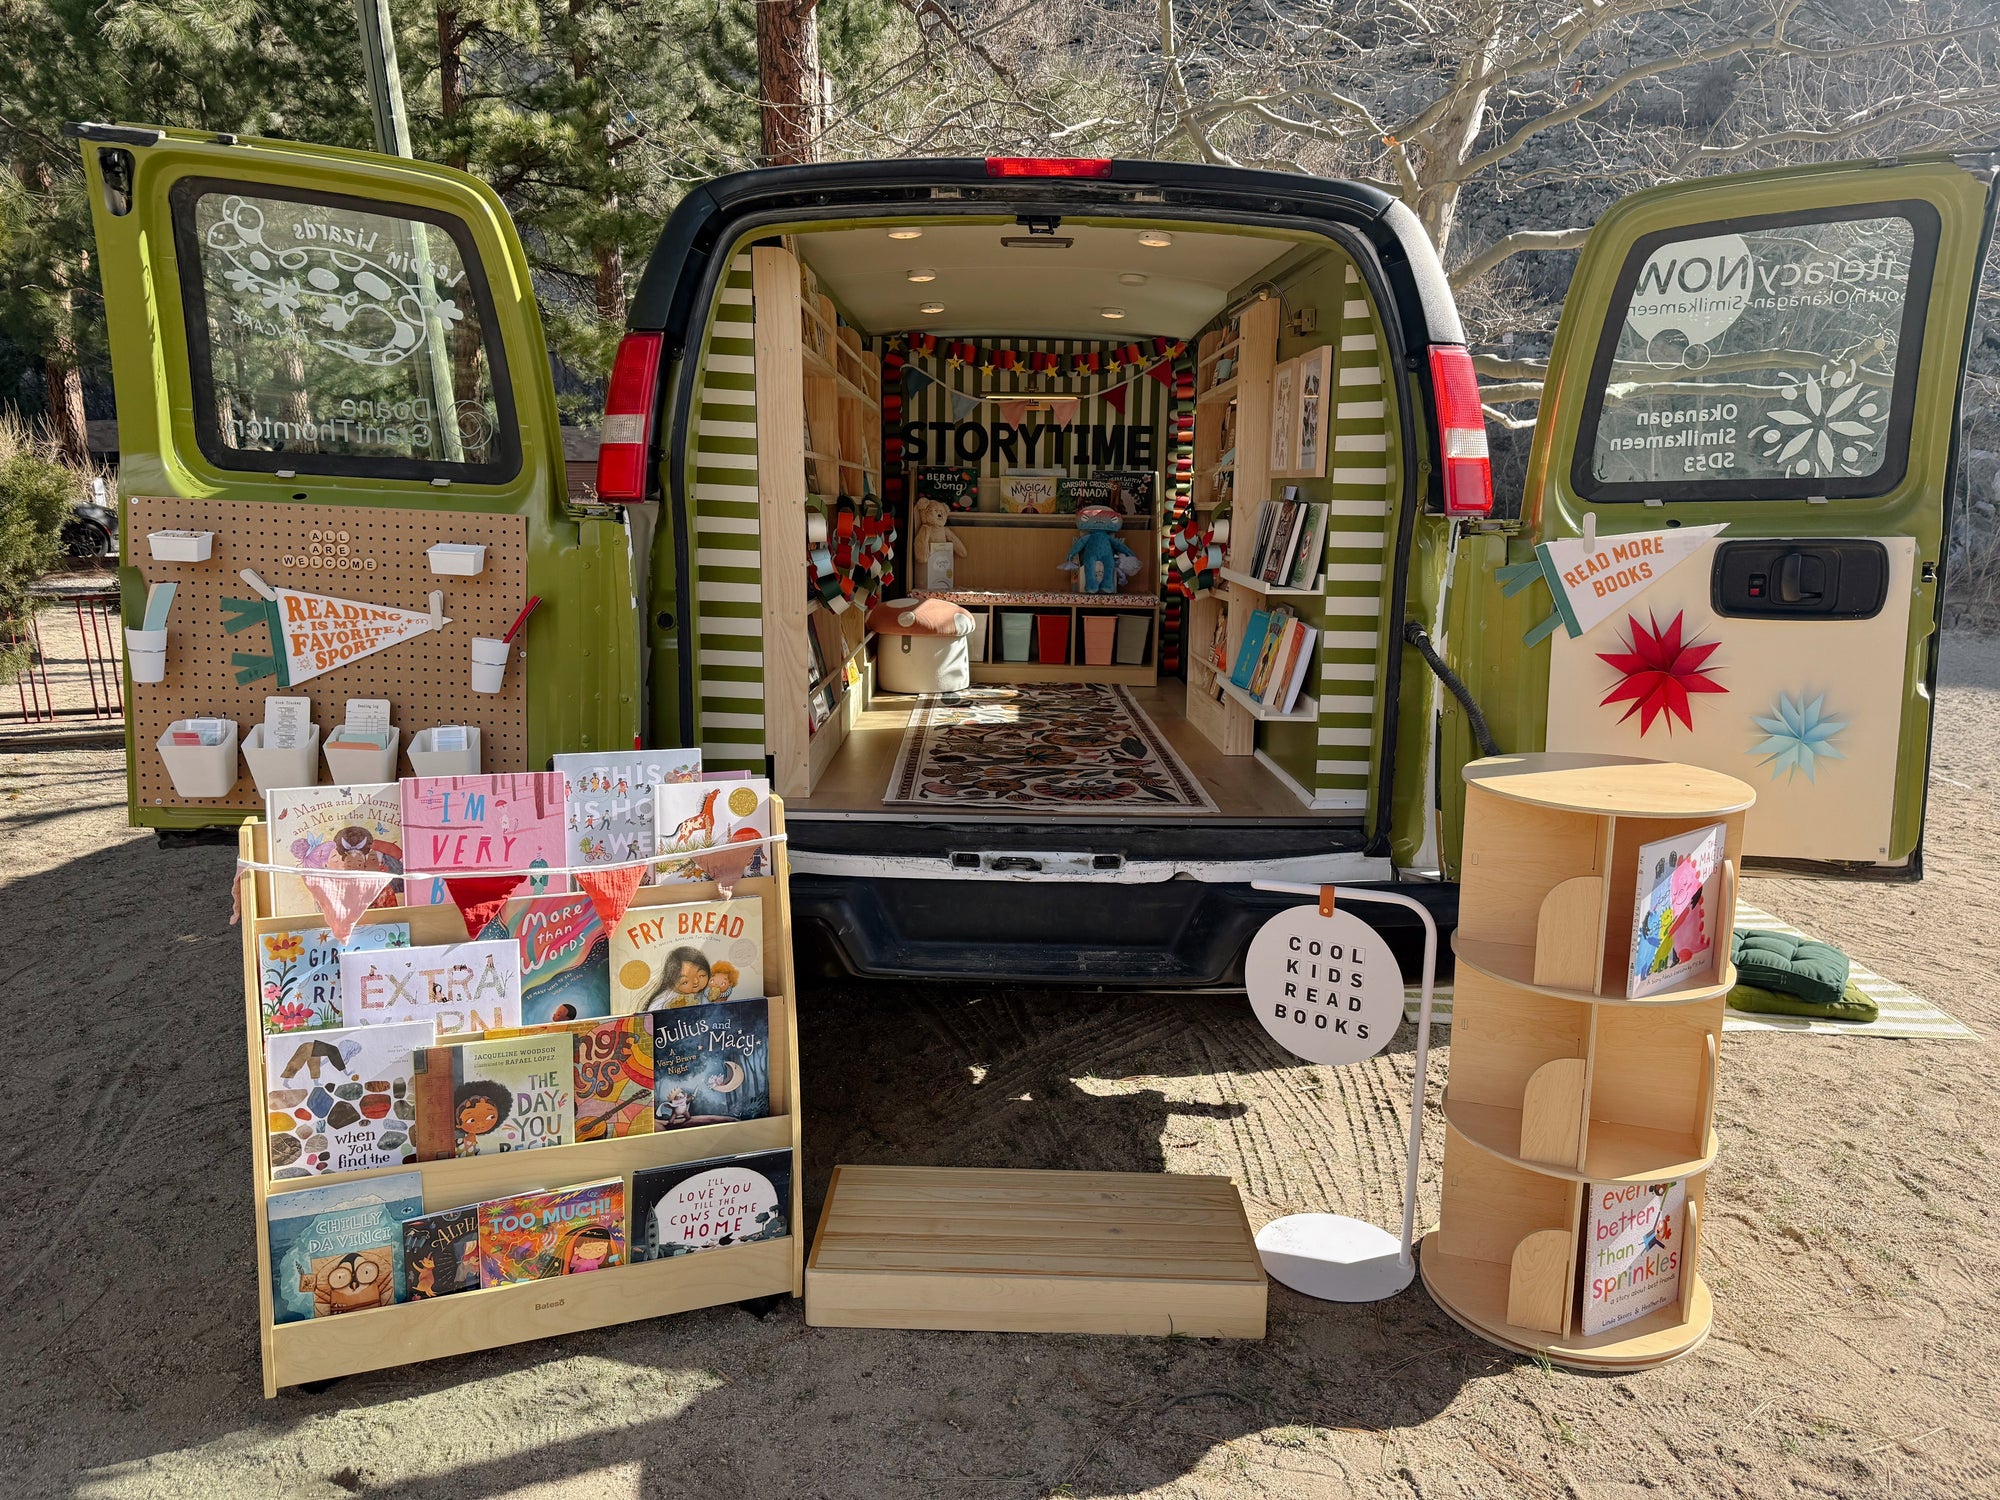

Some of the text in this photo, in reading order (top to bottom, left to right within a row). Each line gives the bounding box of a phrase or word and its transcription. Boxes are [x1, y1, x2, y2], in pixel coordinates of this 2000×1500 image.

[900, 420, 1154, 466] STORYTIME
[926, 473, 960, 482] BERRY
[934, 480, 967, 496] Song
[1011, 482, 1052, 497] MAGICAL
[1062, 480, 1088, 489] CARSON
[1090, 480, 1118, 491] CROSSES
[1022, 491, 1042, 503] YET
[1070, 487, 1108, 498] CANADA
[312, 533, 345, 541] ALL
[312, 546, 345, 555] ARE
[1563, 536, 1665, 588] READ MORE
[284, 557, 374, 569] WELCOME
[1592, 562, 1653, 598] BOOKS
[284, 595, 402, 623] READING
[311, 620, 360, 631] IS MY
[290, 625, 395, 657] FAVORITE
[315, 638, 379, 671] SPORT
[593, 763, 662, 787] THIS
[292, 792, 400, 819] Mama and Momm
[441, 790, 485, 823] I'M
[575, 798, 654, 823] IS HO
[292, 808, 401, 836] and Me in the Midd
[432, 835, 517, 866] VERY
[608, 831, 653, 856] WE
[627, 916, 664, 950] FRY
[678, 911, 745, 939] BREAD
[1289, 936, 1363, 964] COOL
[313, 973, 328, 982] on
[1286, 959, 1363, 988] KIDS
[360, 962, 506, 1010] EXTRA
[1285, 982, 1362, 1012] READ
[655, 1018, 731, 1049] Julius and
[1274, 1003, 1369, 1040] BOOKS
[474, 1046, 556, 1061] JACQUELINE WOODSON
[669, 1048, 676, 1056] A
[708, 1030, 755, 1057] Macy
[505, 1057, 532, 1066] RAFAEL
[656, 1054, 697, 1069] Very Brave
[667, 1064, 689, 1075] Night
[528, 1071, 560, 1091] THE
[517, 1089, 560, 1117] DAY
[334, 1130, 376, 1145] when
[511, 1113, 562, 1142] YOU
[338, 1153, 367, 1169] find
[370, 1152, 391, 1164] the
[347, 1142, 373, 1156] you
[679, 1182, 752, 1203] LOVE YOU
[708, 1177, 725, 1187] I'LL
[670, 1202, 757, 1226] COWS COME
[693, 1197, 736, 1210] TILL THE
[316, 1210, 383, 1235] CHILLY
[489, 1197, 612, 1235] TOO MUCH!
[1596, 1205, 1655, 1242] better
[309, 1227, 393, 1254] DA VINCI
[431, 1216, 478, 1252] ALPH
[683, 1217, 743, 1240] HOME
[1597, 1243, 1634, 1267] than
[1592, 1252, 1678, 1303] sprinkles
[1631, 1286, 1646, 1296] about
[1634, 1307, 1640, 1315] &
